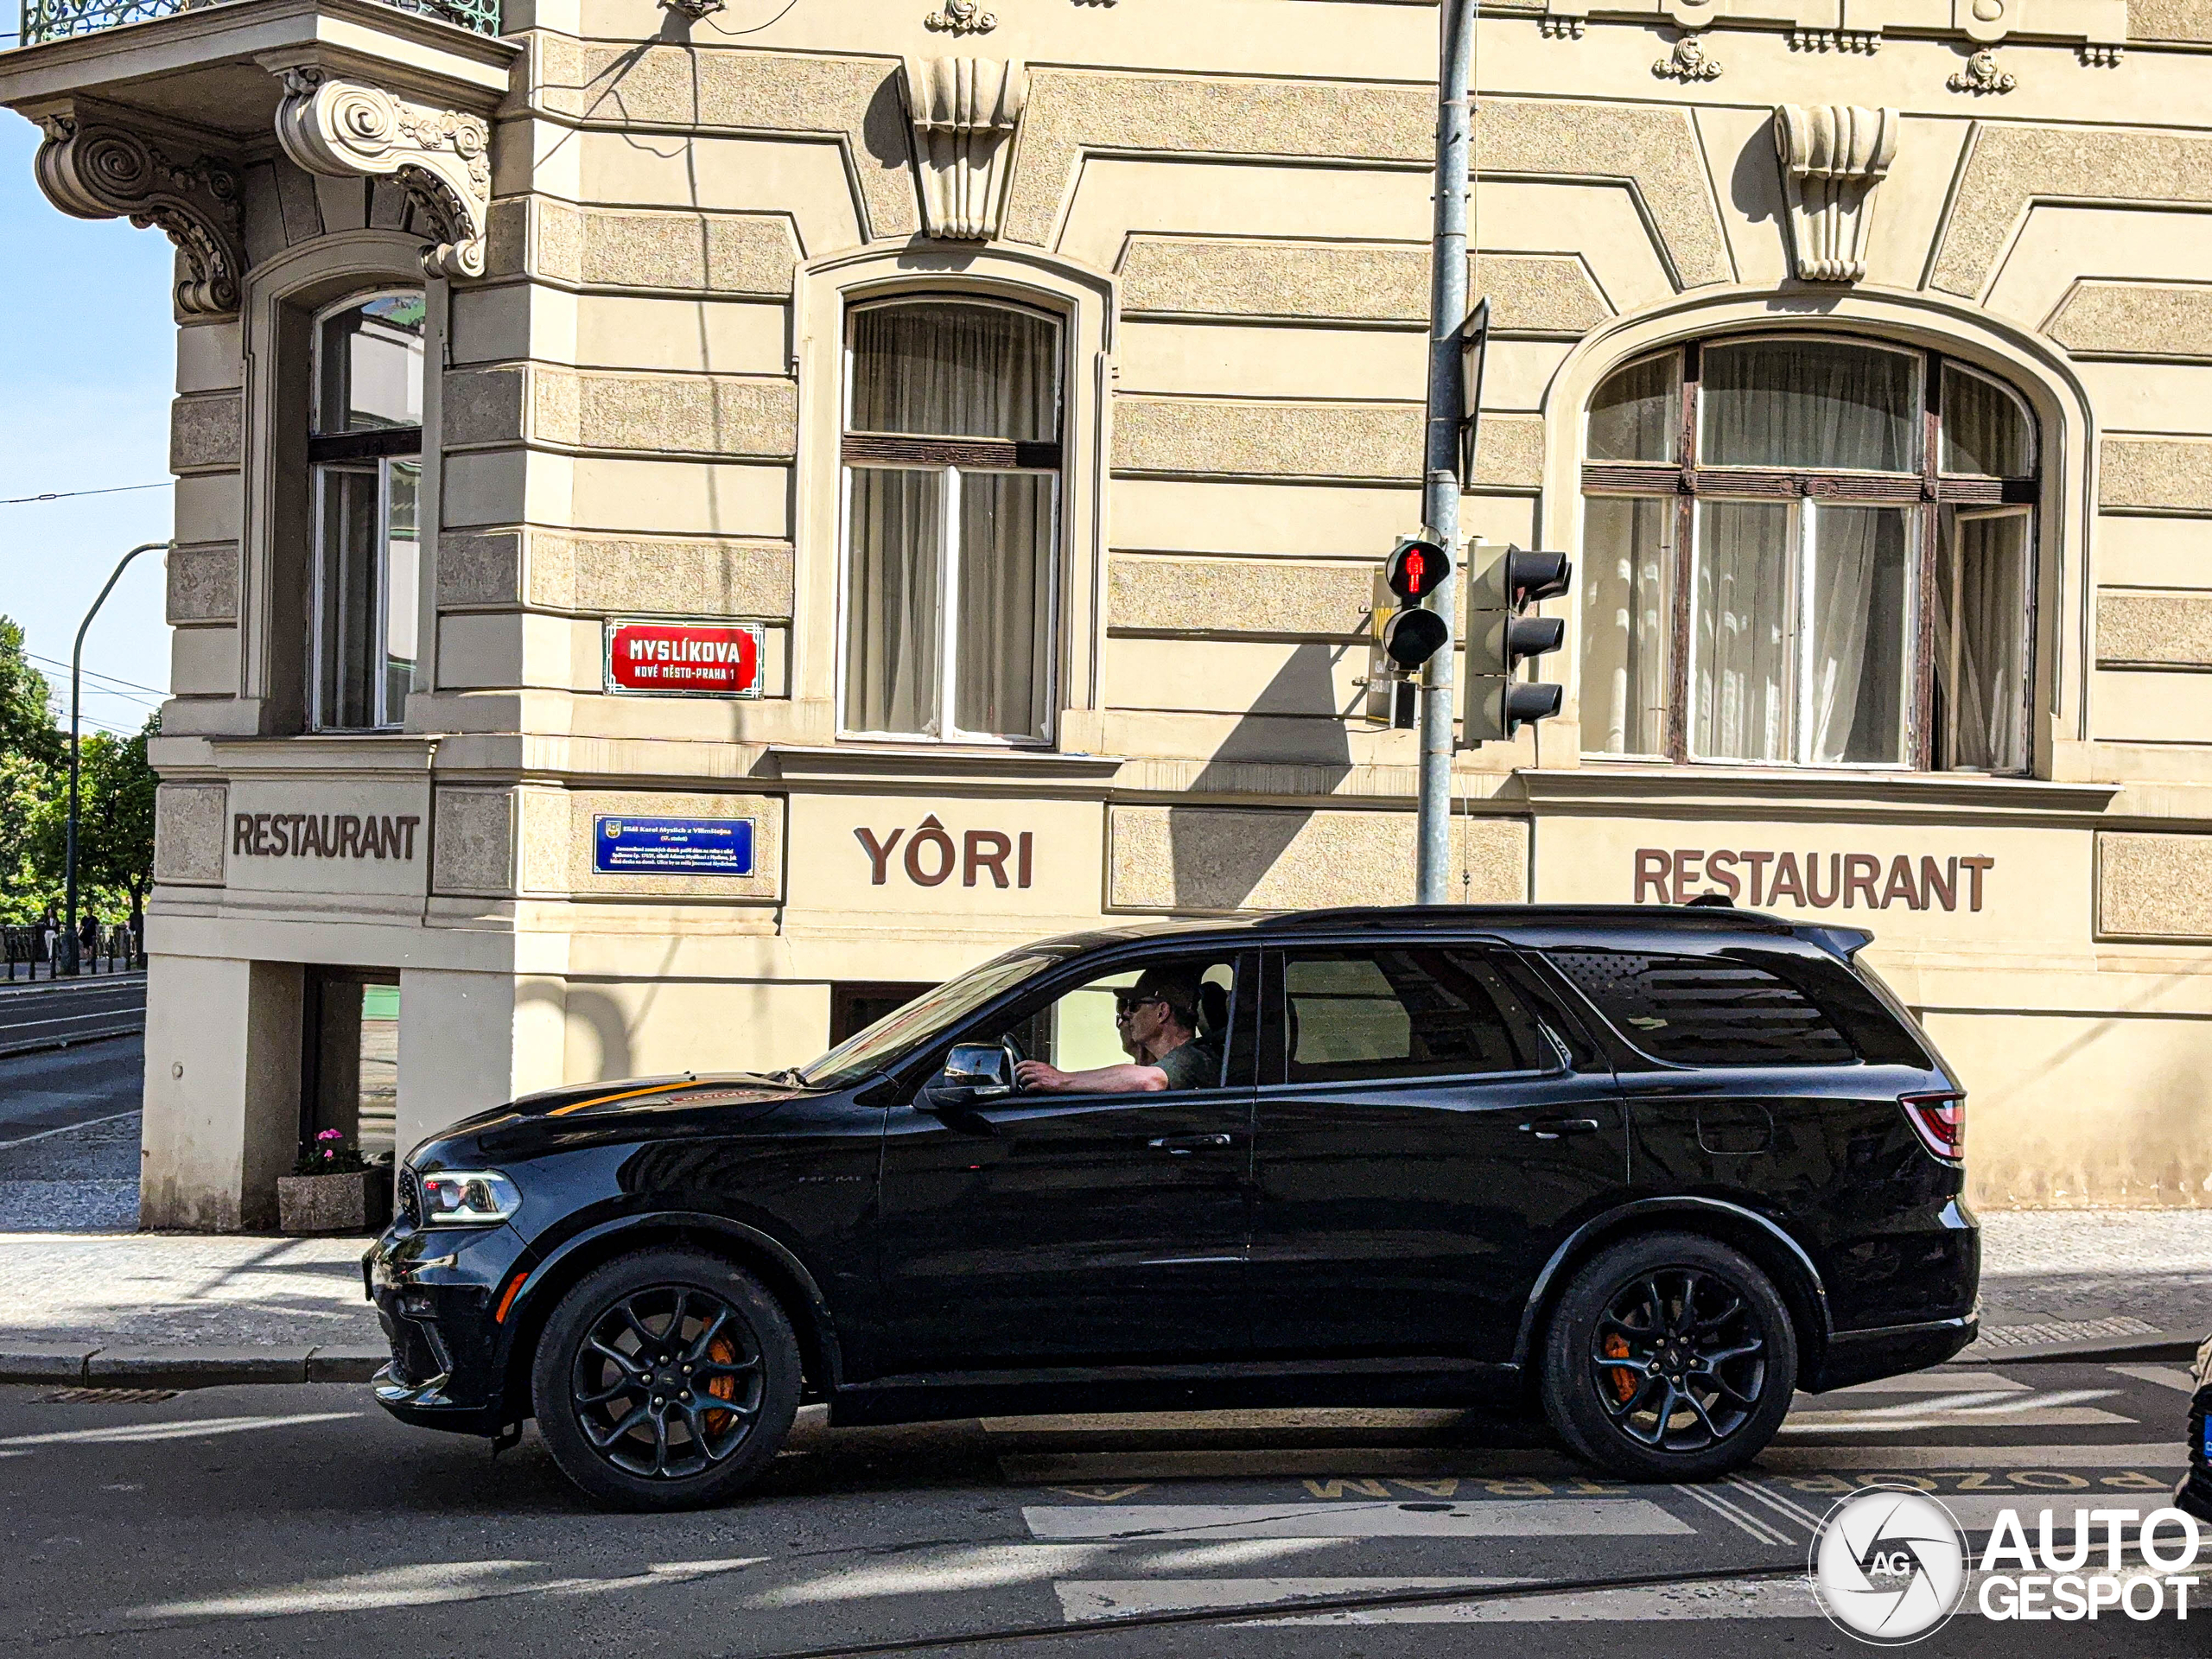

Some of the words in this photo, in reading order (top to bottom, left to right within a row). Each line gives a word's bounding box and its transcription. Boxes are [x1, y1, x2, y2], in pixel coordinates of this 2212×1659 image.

[630, 637, 741, 664] MYSLÍKOVA
[634, 664, 658, 677] NOVÉ
[663, 664, 727, 680] MĚSTO-PRAHA
[730, 669, 734, 679] 1
[232, 813, 421, 860] RESTAURANT
[853, 813, 1033, 889] YÔRI
[1633, 848, 1995, 912] RESTAURANT
